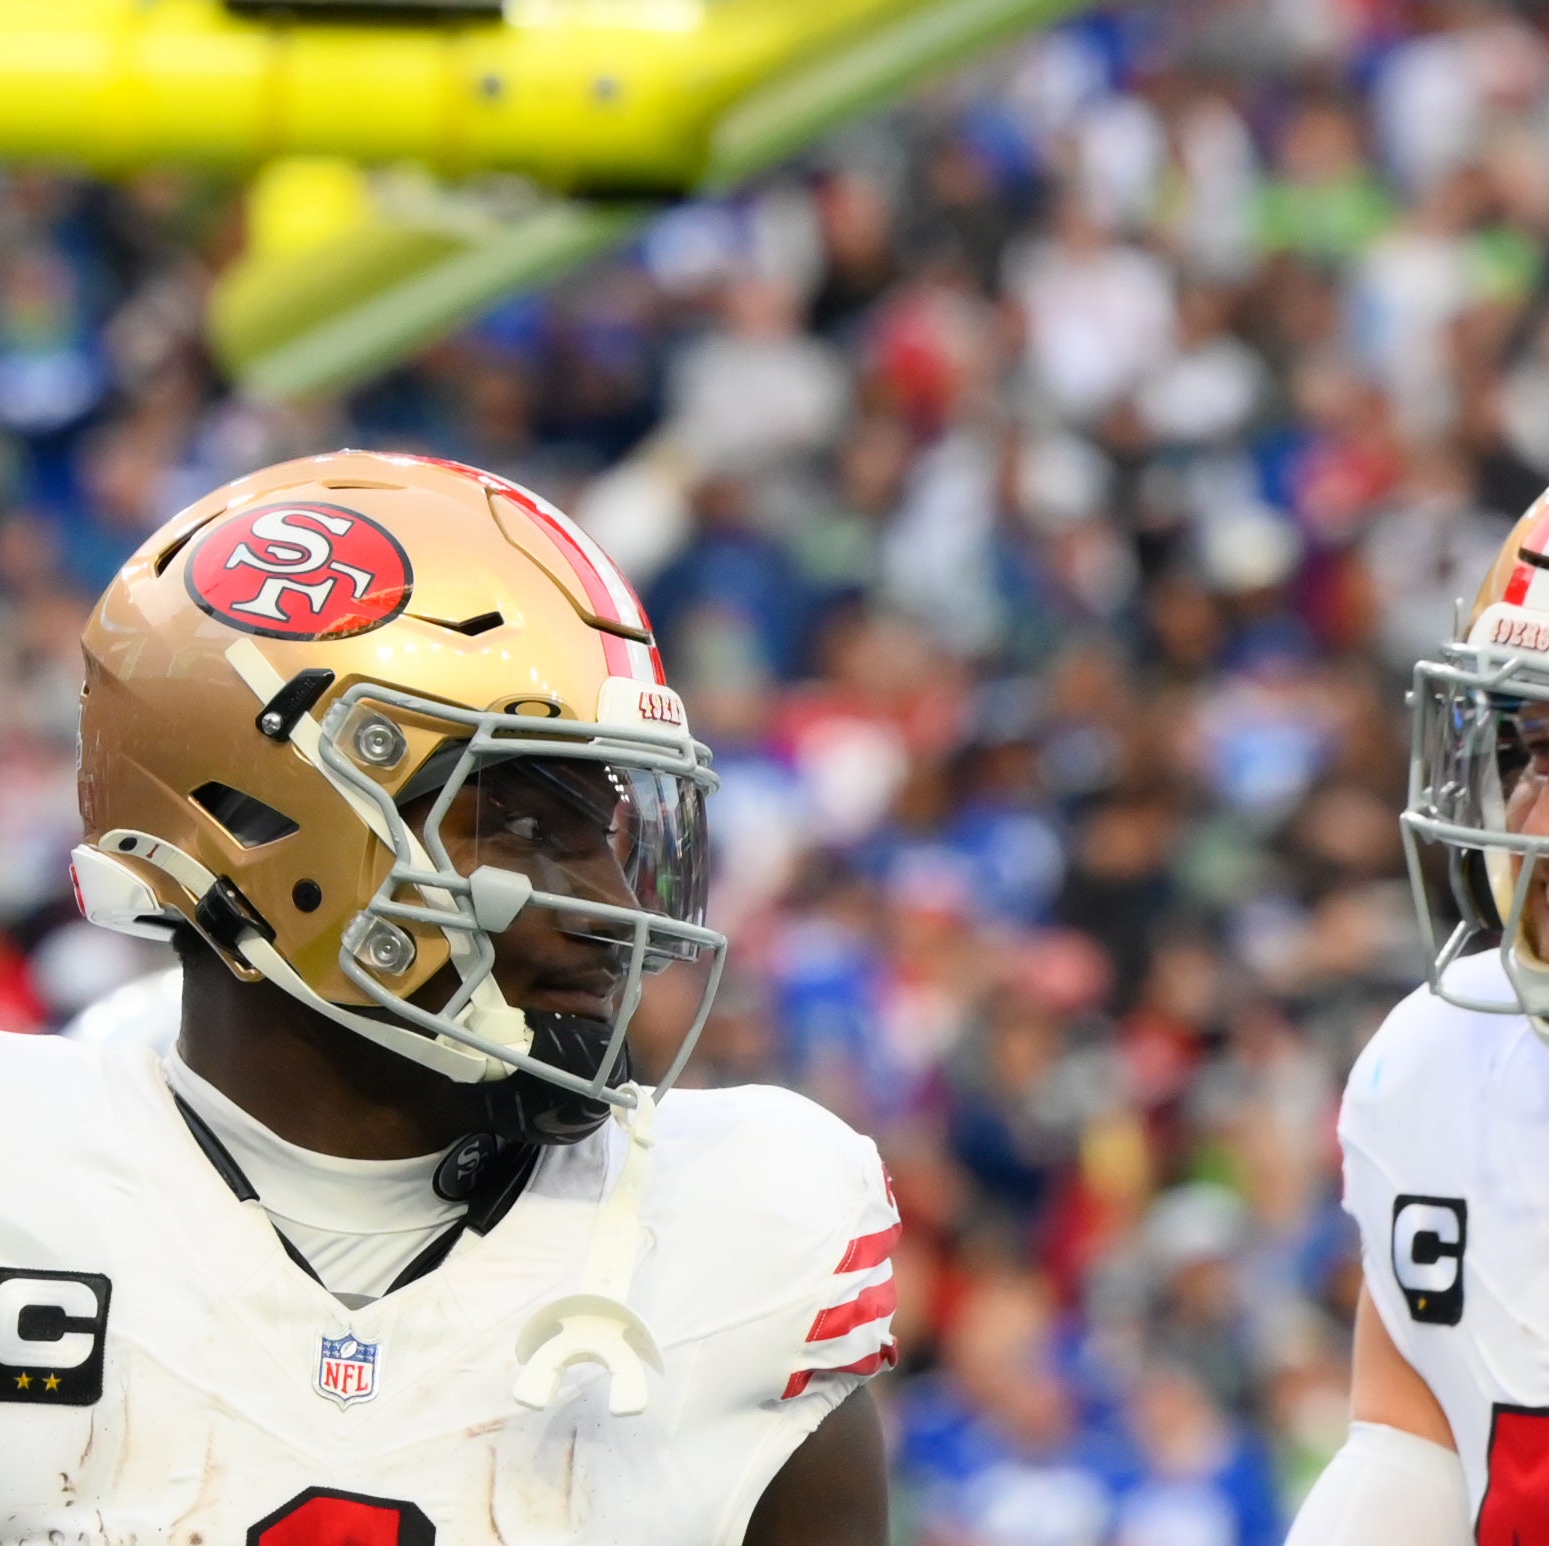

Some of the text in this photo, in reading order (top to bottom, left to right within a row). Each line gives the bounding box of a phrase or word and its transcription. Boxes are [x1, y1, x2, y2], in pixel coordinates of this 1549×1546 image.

[224, 509, 375, 622] SF
[1393, 1202, 1460, 1293] C
[323, 1361, 369, 1394] NFL
